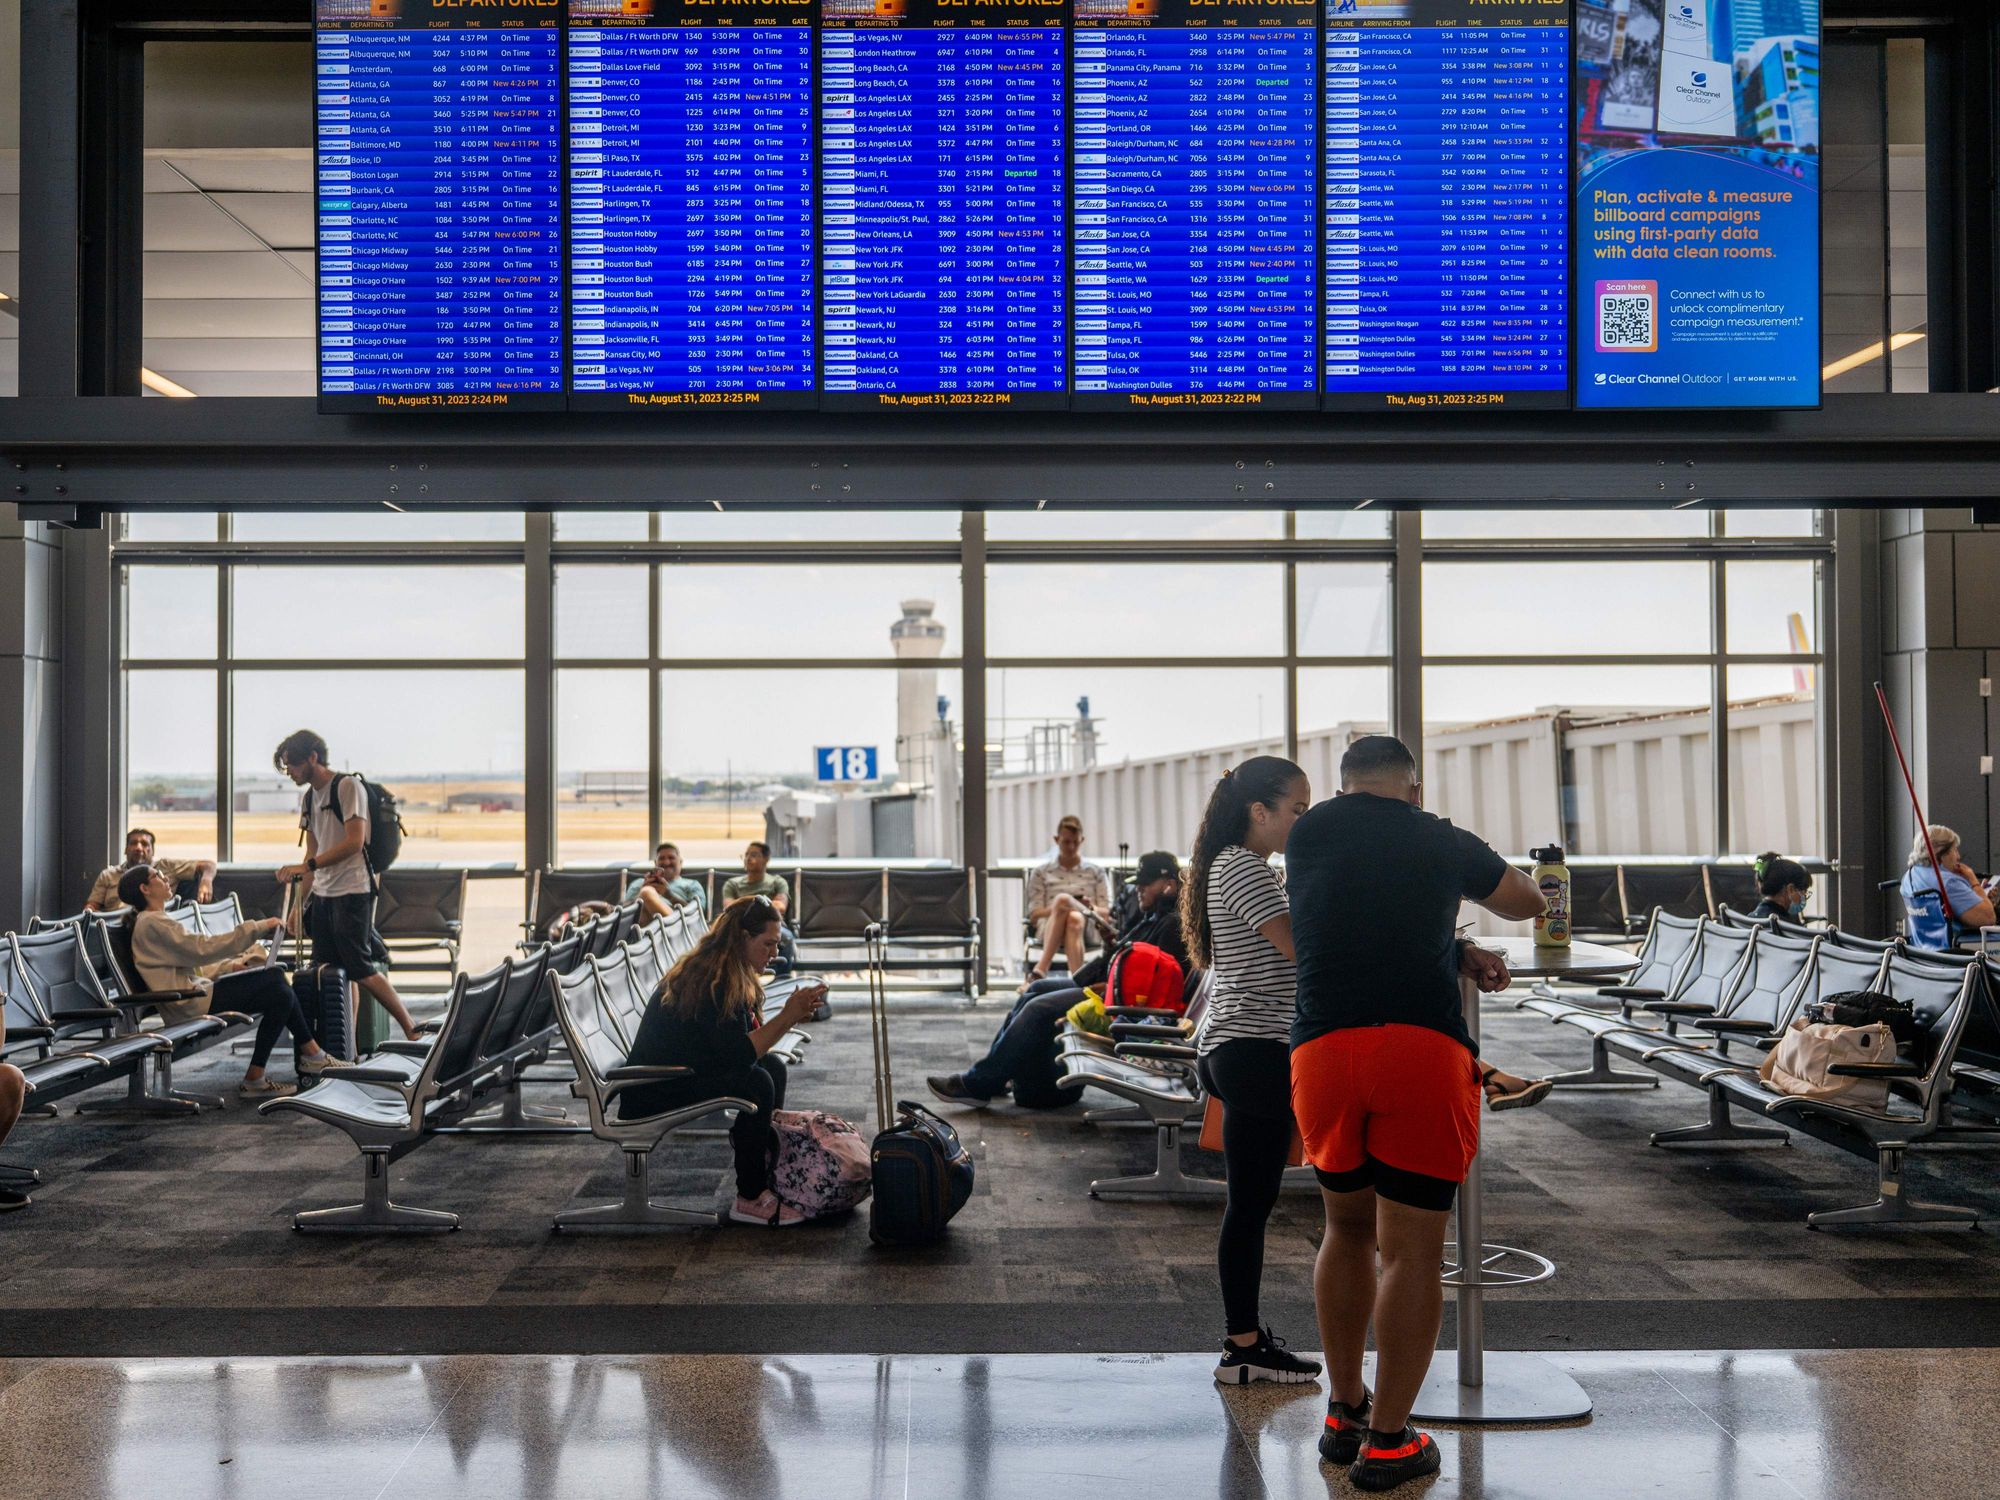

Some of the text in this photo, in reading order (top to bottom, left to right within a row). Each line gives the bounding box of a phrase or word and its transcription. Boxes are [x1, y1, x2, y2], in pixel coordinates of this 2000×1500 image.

[1668, 13, 1703, 27] Clear Channel
[1676, 20, 1697, 30] Outdoor
[1329, 33, 1357, 42] Alaska
[1106, 79, 1136, 87] Phoenix,
[1256, 79, 1289, 87] Departed
[1676, 85, 1721, 98] Clear Channel
[1685, 94, 1711, 105] Outdoor
[321, 156, 348, 164] Alaska
[574, 169, 598, 177] spirit
[802, 168, 807, 176] 5
[1595, 190, 1792, 204] Plan, activate & measure
[1595, 208, 1760, 224] billboard campaigns
[1594, 227, 1758, 243] using first-party data
[352, 247, 380, 255] Chicago
[381, 247, 408, 255] Midway
[1594, 245, 1776, 258] with data clean rooms.
[829, 275, 850, 284] jetBlue
[1628, 283, 1646, 291] here
[1670, 290, 1715, 299] Connect
[1718, 289, 1739, 298] with
[1755, 289, 1765, 299] to
[1670, 303, 1785, 314] unlock complimentary
[1107, 321, 1132, 329] Tampa,
[1670, 317, 1724, 328] campaign
[1608, 374, 1722, 384] Clear Channel Outdoor
[377, 395, 507, 406] Thu, August 31, 2023 2:24 PM
[628, 393, 759, 405] Thu, August 31, 2023 2:25 PM
[879, 394, 1010, 405] Thu, August 31, 2023 2:22 PM
[1130, 394, 1261, 405] Thu, August 31, 2023 2:22 PM
[1386, 395, 1503, 406] Thu, Aug 31, 2023 2:25 PM
[826, 748, 868, 781] 18
